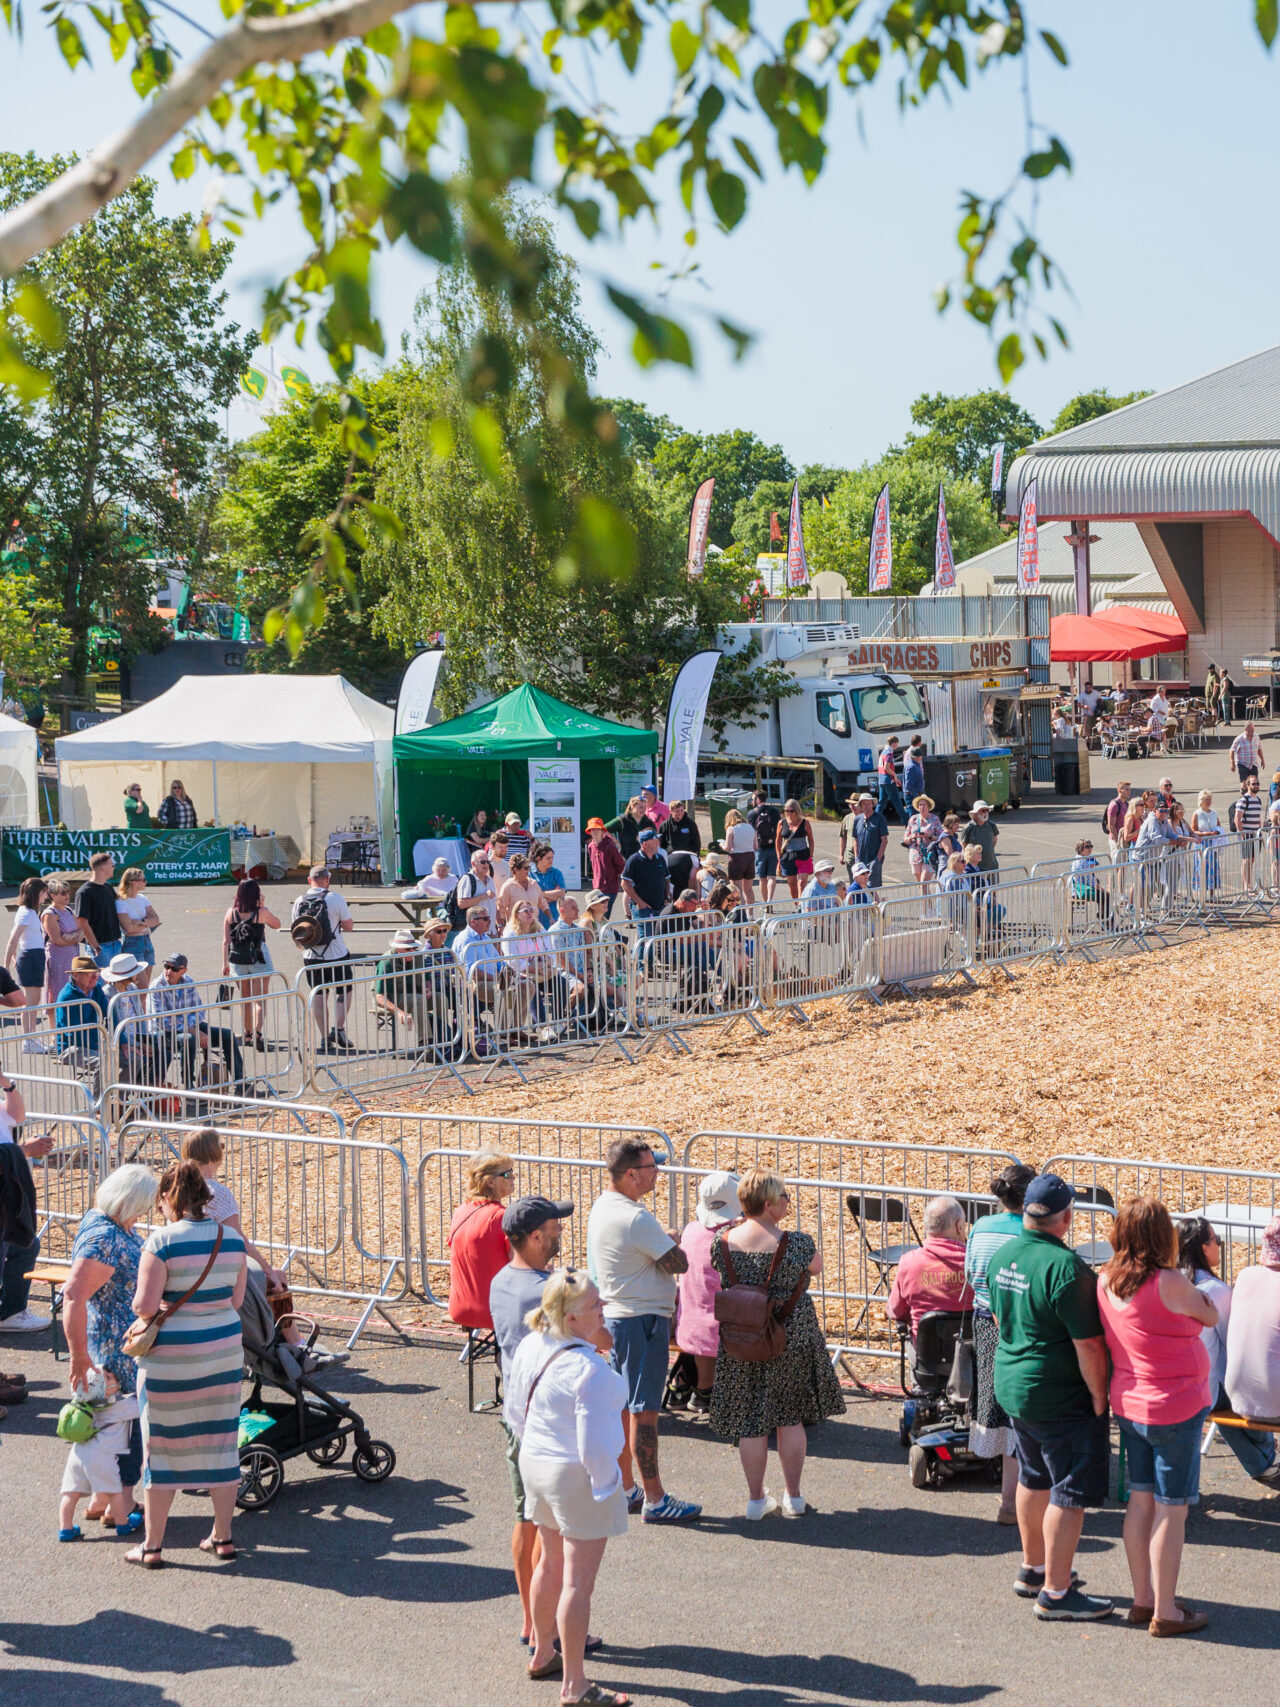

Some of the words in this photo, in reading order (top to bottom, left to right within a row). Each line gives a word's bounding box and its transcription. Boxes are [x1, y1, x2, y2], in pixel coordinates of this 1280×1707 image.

[848, 643, 940, 671] SAUSAGES
[970, 641, 1012, 668] CHIPS
[679, 708, 695, 744] VALE
[466, 746, 485, 754] VALE
[4, 831, 63, 846] THREE
[66, 831, 142, 847] VALLEYS
[18, 847, 129, 864] VETERINRY
[146, 862, 184, 870] OTTERY
[185, 862, 199, 870] ST.
[201, 862, 229, 870] MARY
[922, 1271, 968, 1286] SALTROC
